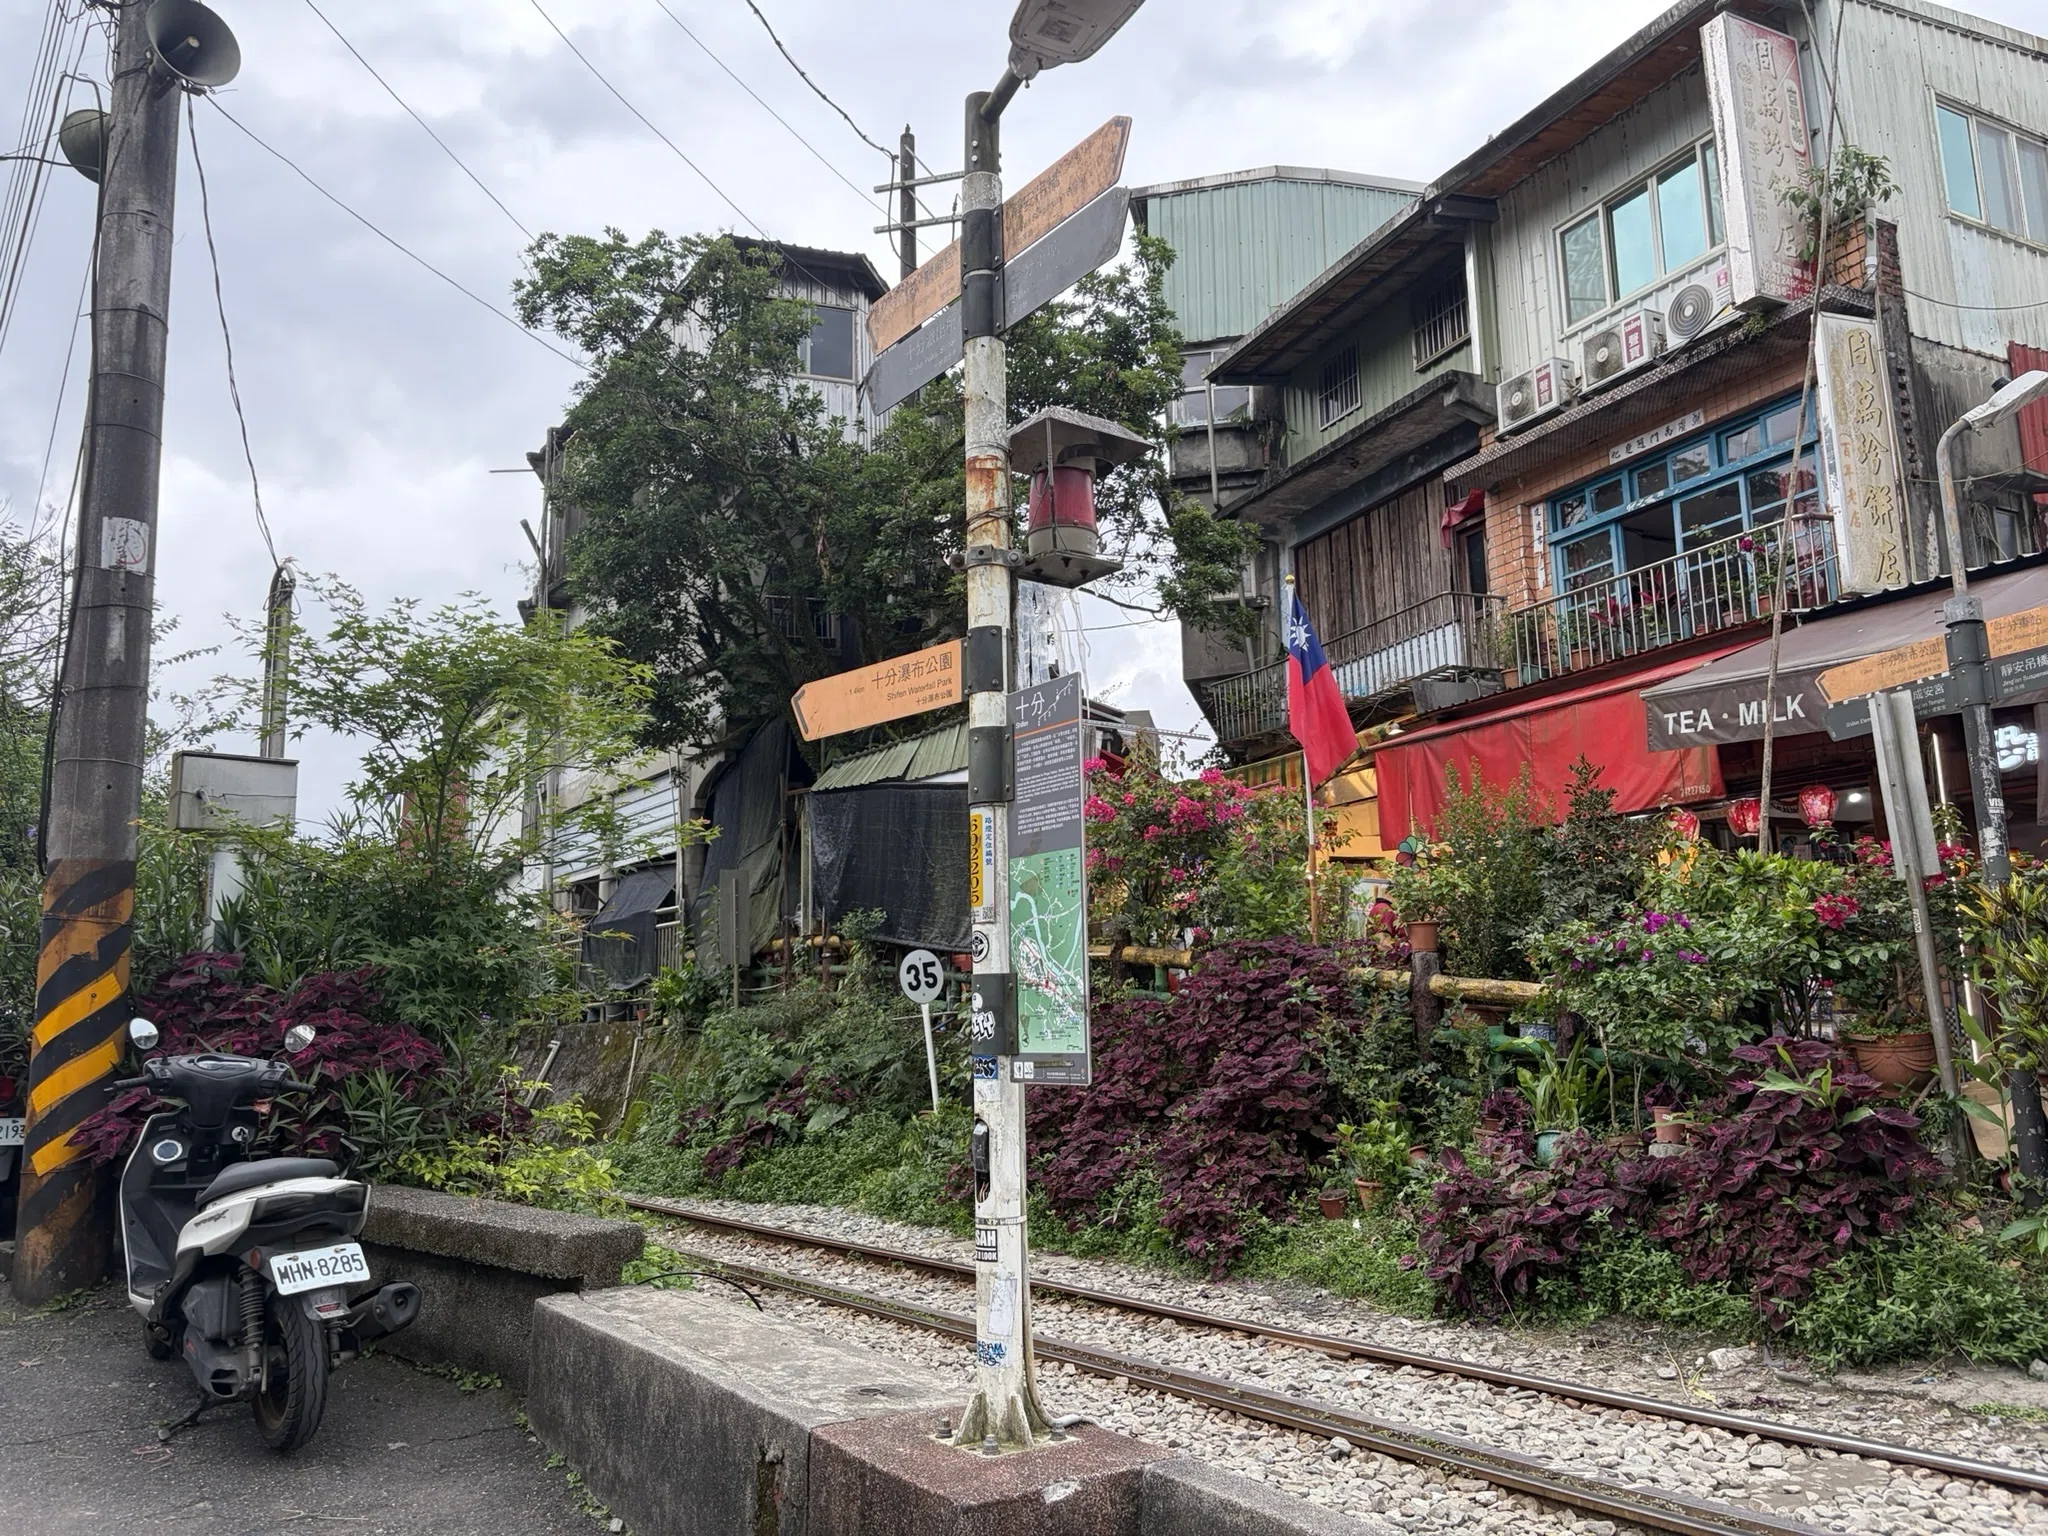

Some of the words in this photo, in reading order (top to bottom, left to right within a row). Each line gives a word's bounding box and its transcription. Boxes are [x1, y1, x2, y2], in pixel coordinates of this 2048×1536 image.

[871, 651, 953, 690] 十分瀑布公園
[886, 688, 907, 701] Shifen
[908, 681, 936, 696] Waterfall
[937, 677, 953, 688] Park
[1015, 691, 1045, 720] 十分
[1664, 708, 1714, 735] TEA
[1739, 693, 1806, 727] MILK
[1015, 720, 1029, 730] Shifen
[906, 961, 938, 991] 35
[277, 1253, 364, 1285] MHN-8285
